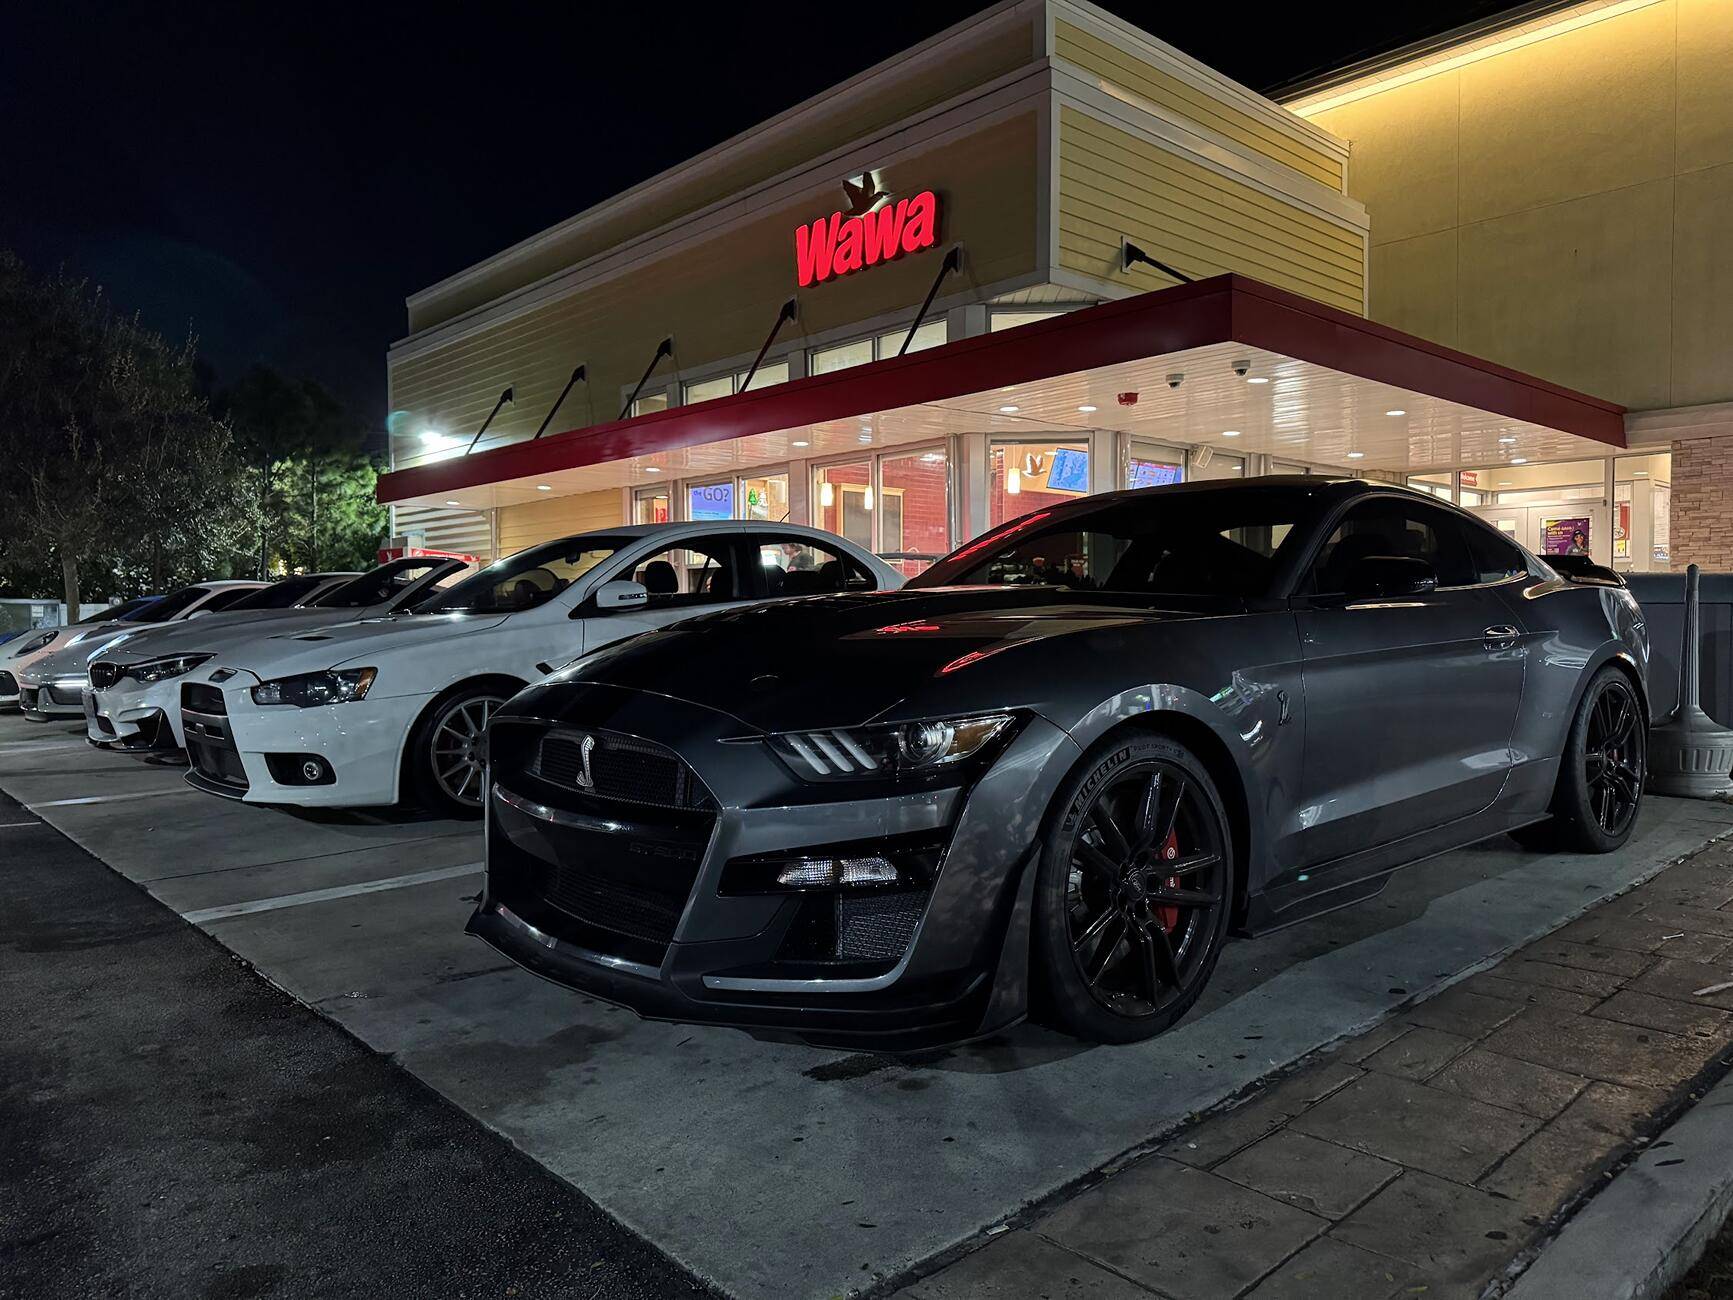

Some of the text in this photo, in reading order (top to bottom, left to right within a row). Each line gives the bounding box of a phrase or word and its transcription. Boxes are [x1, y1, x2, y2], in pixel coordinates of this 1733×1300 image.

[795, 190, 936, 287] Wawa
[703, 487, 730, 502] GO?
[1074, 748, 1127, 811] MICHELIN
